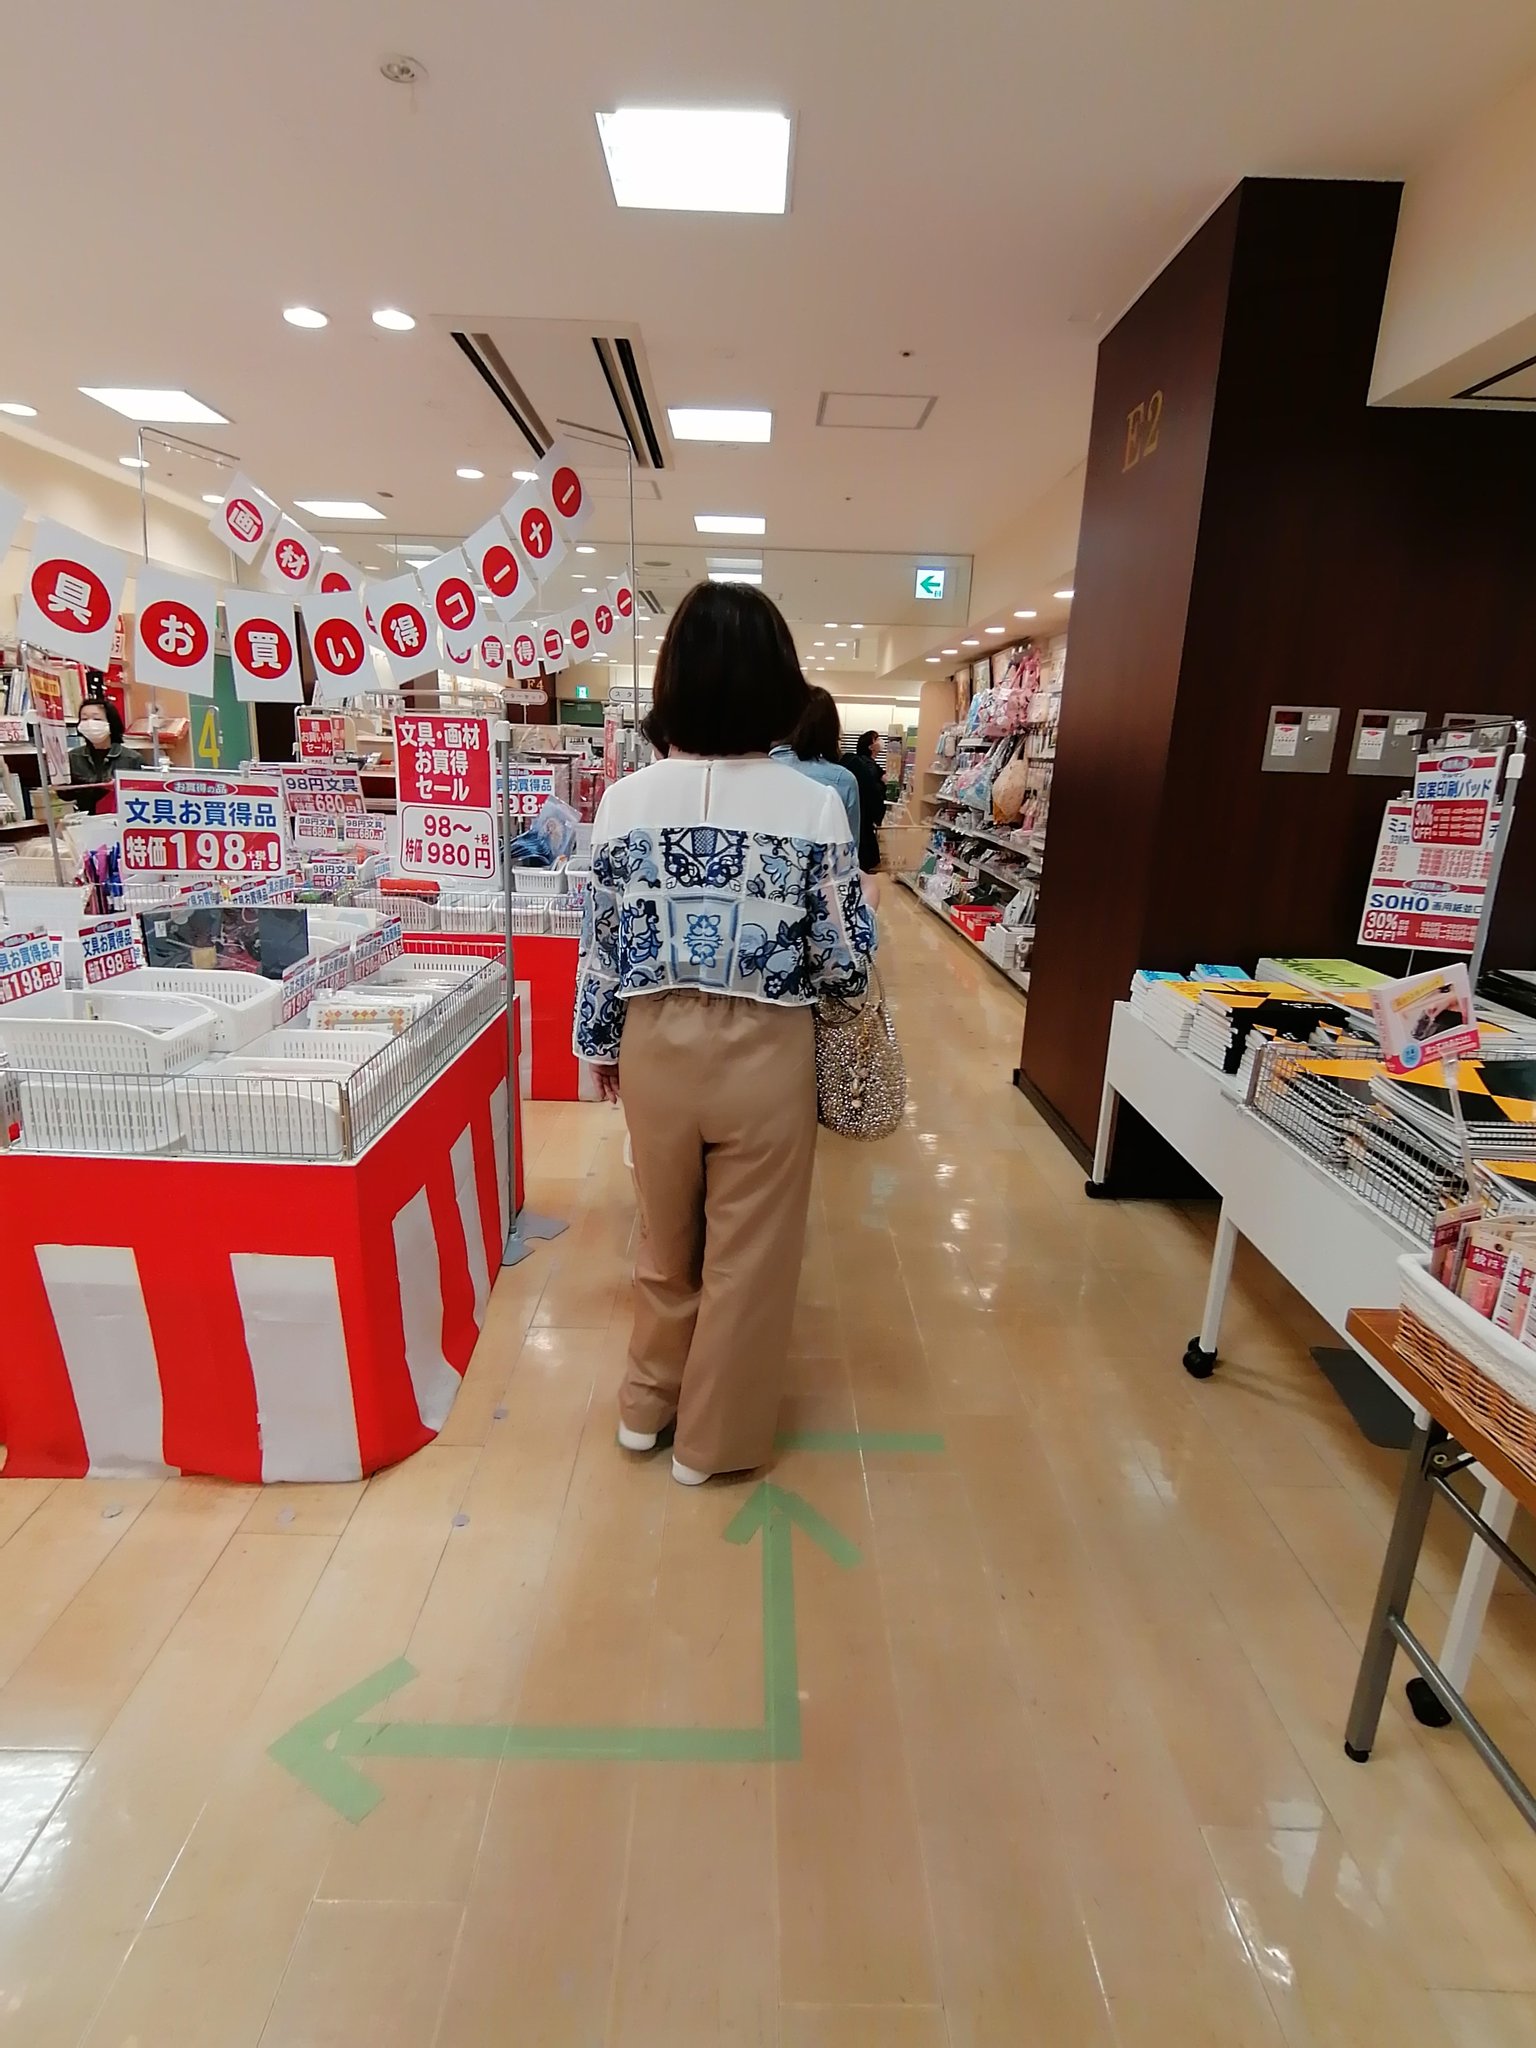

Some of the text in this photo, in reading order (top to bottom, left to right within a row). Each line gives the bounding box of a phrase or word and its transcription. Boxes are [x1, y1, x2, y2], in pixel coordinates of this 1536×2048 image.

[1121, 389, 1163, 474] E2
[526, 678, 544, 690] F4
[198, 708, 220, 768] 4
[398, 720, 481, 750] 文具・画材
[415, 748, 469, 776] お買得
[285, 777, 358, 793] 98円文具
[415, 775, 470, 801] セール
[125, 797, 277, 828] 文具お買得品
[1370, 893, 1430, 912] SOHO
[1368, 911, 1399, 930] 30%
[1363, 929, 1396, 941] OFF!
